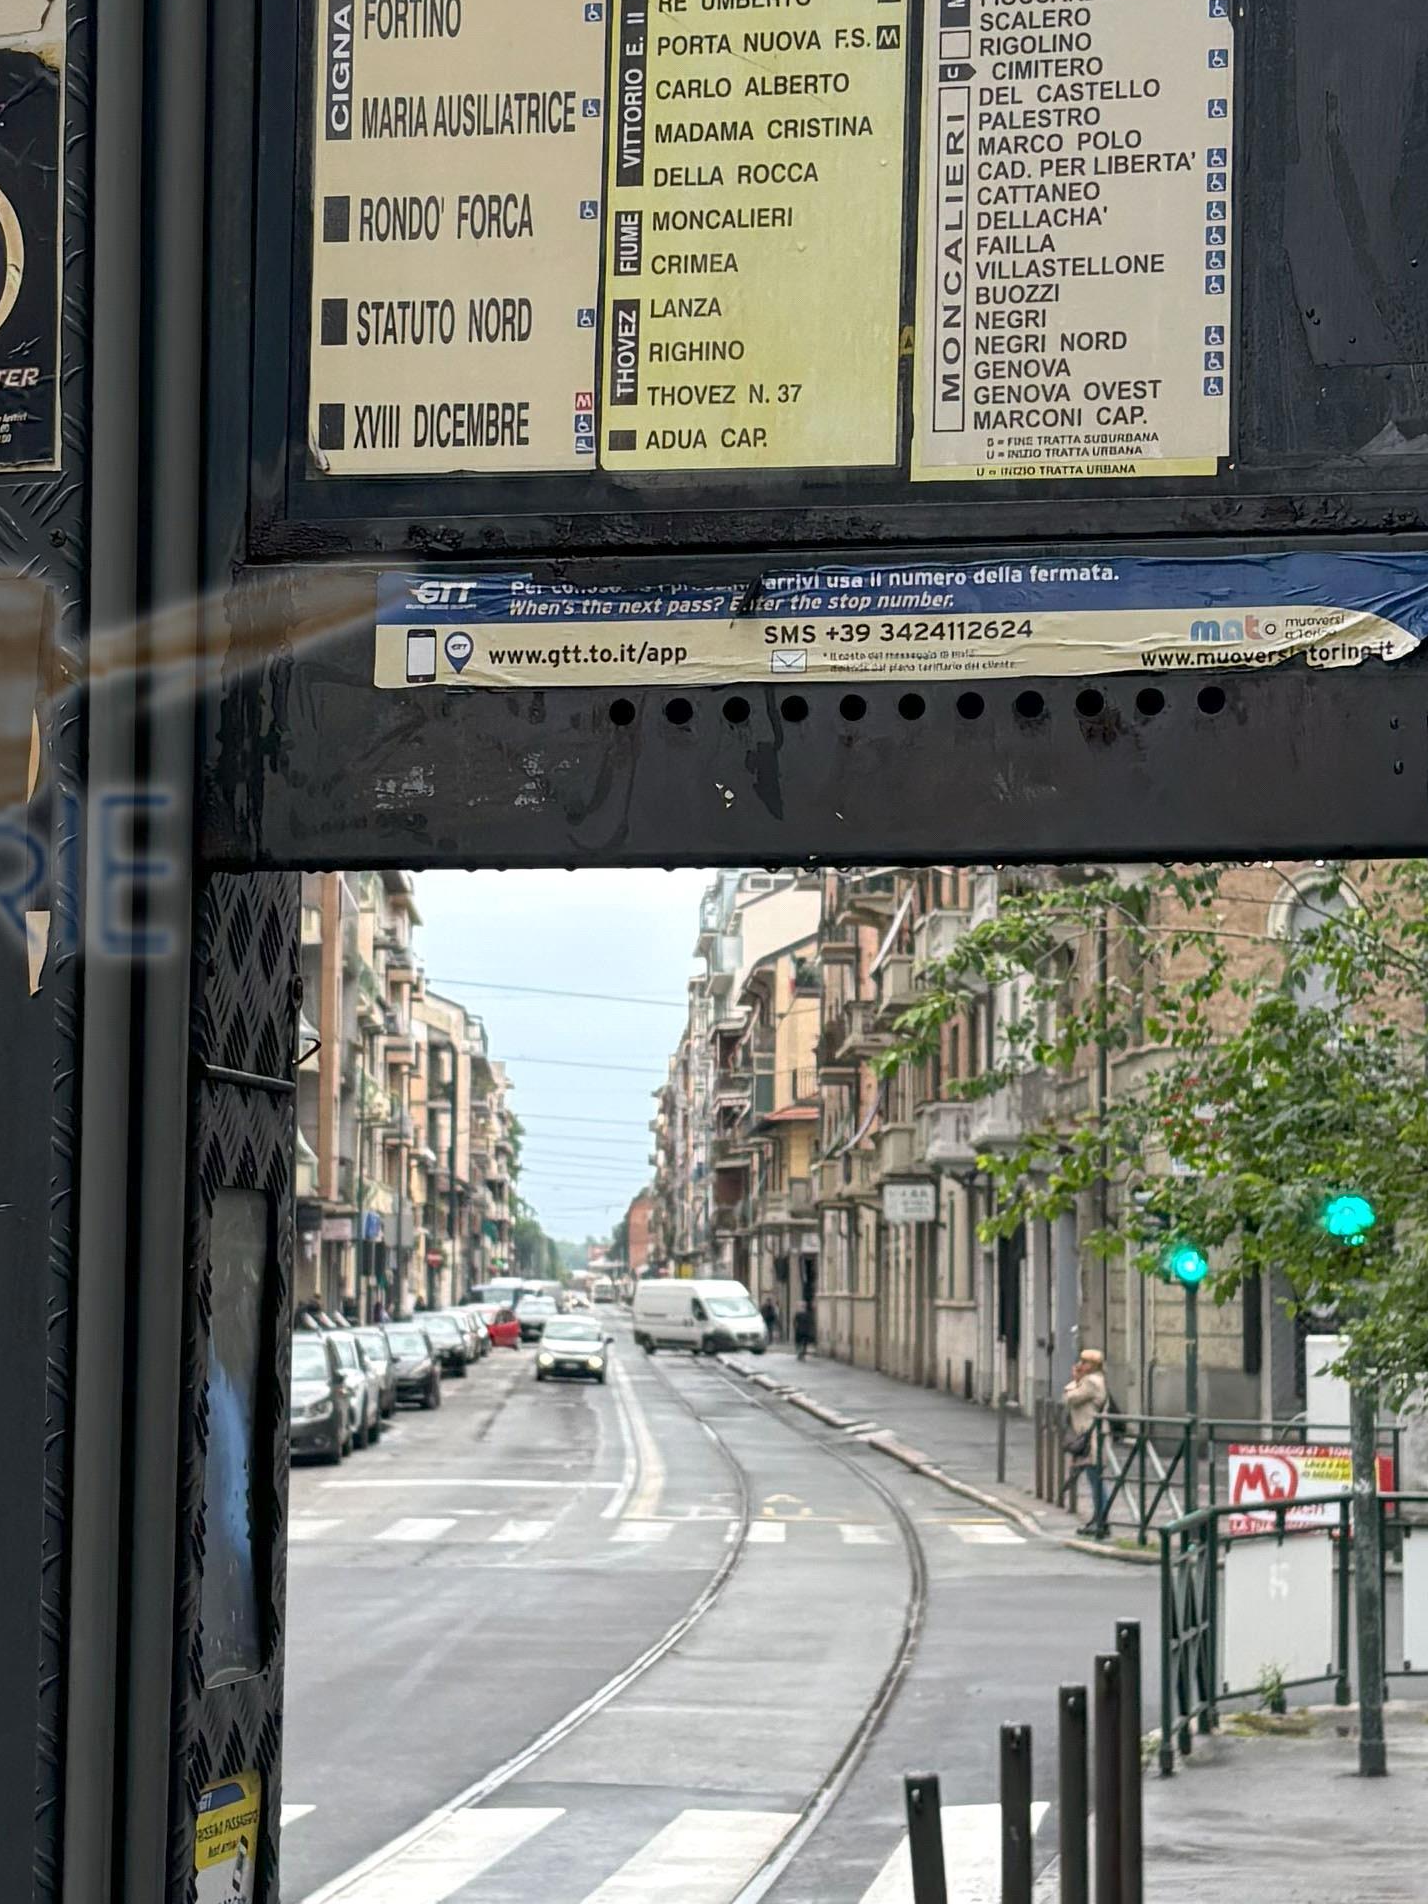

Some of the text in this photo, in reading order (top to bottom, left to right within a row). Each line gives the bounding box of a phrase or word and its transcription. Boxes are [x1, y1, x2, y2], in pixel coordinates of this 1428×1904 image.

[657, 28, 871, 56] PORTA NUOVA F.S.
[331, 3, 352, 133] CIGNA
[622, 12, 644, 168] VITTORIO E. II
[362, 91, 576, 139] MARIA AUSILIATRICE
[978, 107, 1100, 130] PALESTRO
[654, 116, 873, 144] MADAMA CRISTINA
[360, 193, 533, 242] RONDO' FORCA
[652, 207, 793, 231] MONCALIERI
[977, 207, 1107, 230] DELLACHA'
[620, 214, 639, 272] FIUME
[941, 115, 964, 402] MONCALIERI
[976, 254, 1164, 279] VILLASTELLONE
[357, 297, 532, 346] STATUTO NORD
[616, 309, 636, 397] THOVEZ
[354, 402, 529, 449] XVIII DICEMBRE
[974, 406, 1147, 430] MARCONI CAP.
[645, 427, 768, 450] ADUA CAP.
[827, 574, 863, 588] usa
[870, 572, 882, 586] il
[889, 571, 967, 587] numero
[973, 565, 1022, 584] della
[1030, 564, 1120, 582] fermata.
[412, 582, 477, 604] GTT
[509, 599, 574, 616] When's
[582, 599, 611, 614] the
[619, 598, 660, 614] next
[667, 596, 723, 616] pass?
[790, 594, 822, 611] the
[828, 592, 871, 612] stop
[877, 591, 954, 609] number.
[764, 620, 1033, 644] SMS +39 3424112624
[489, 641, 687, 667] www.gtt.to.it/app
